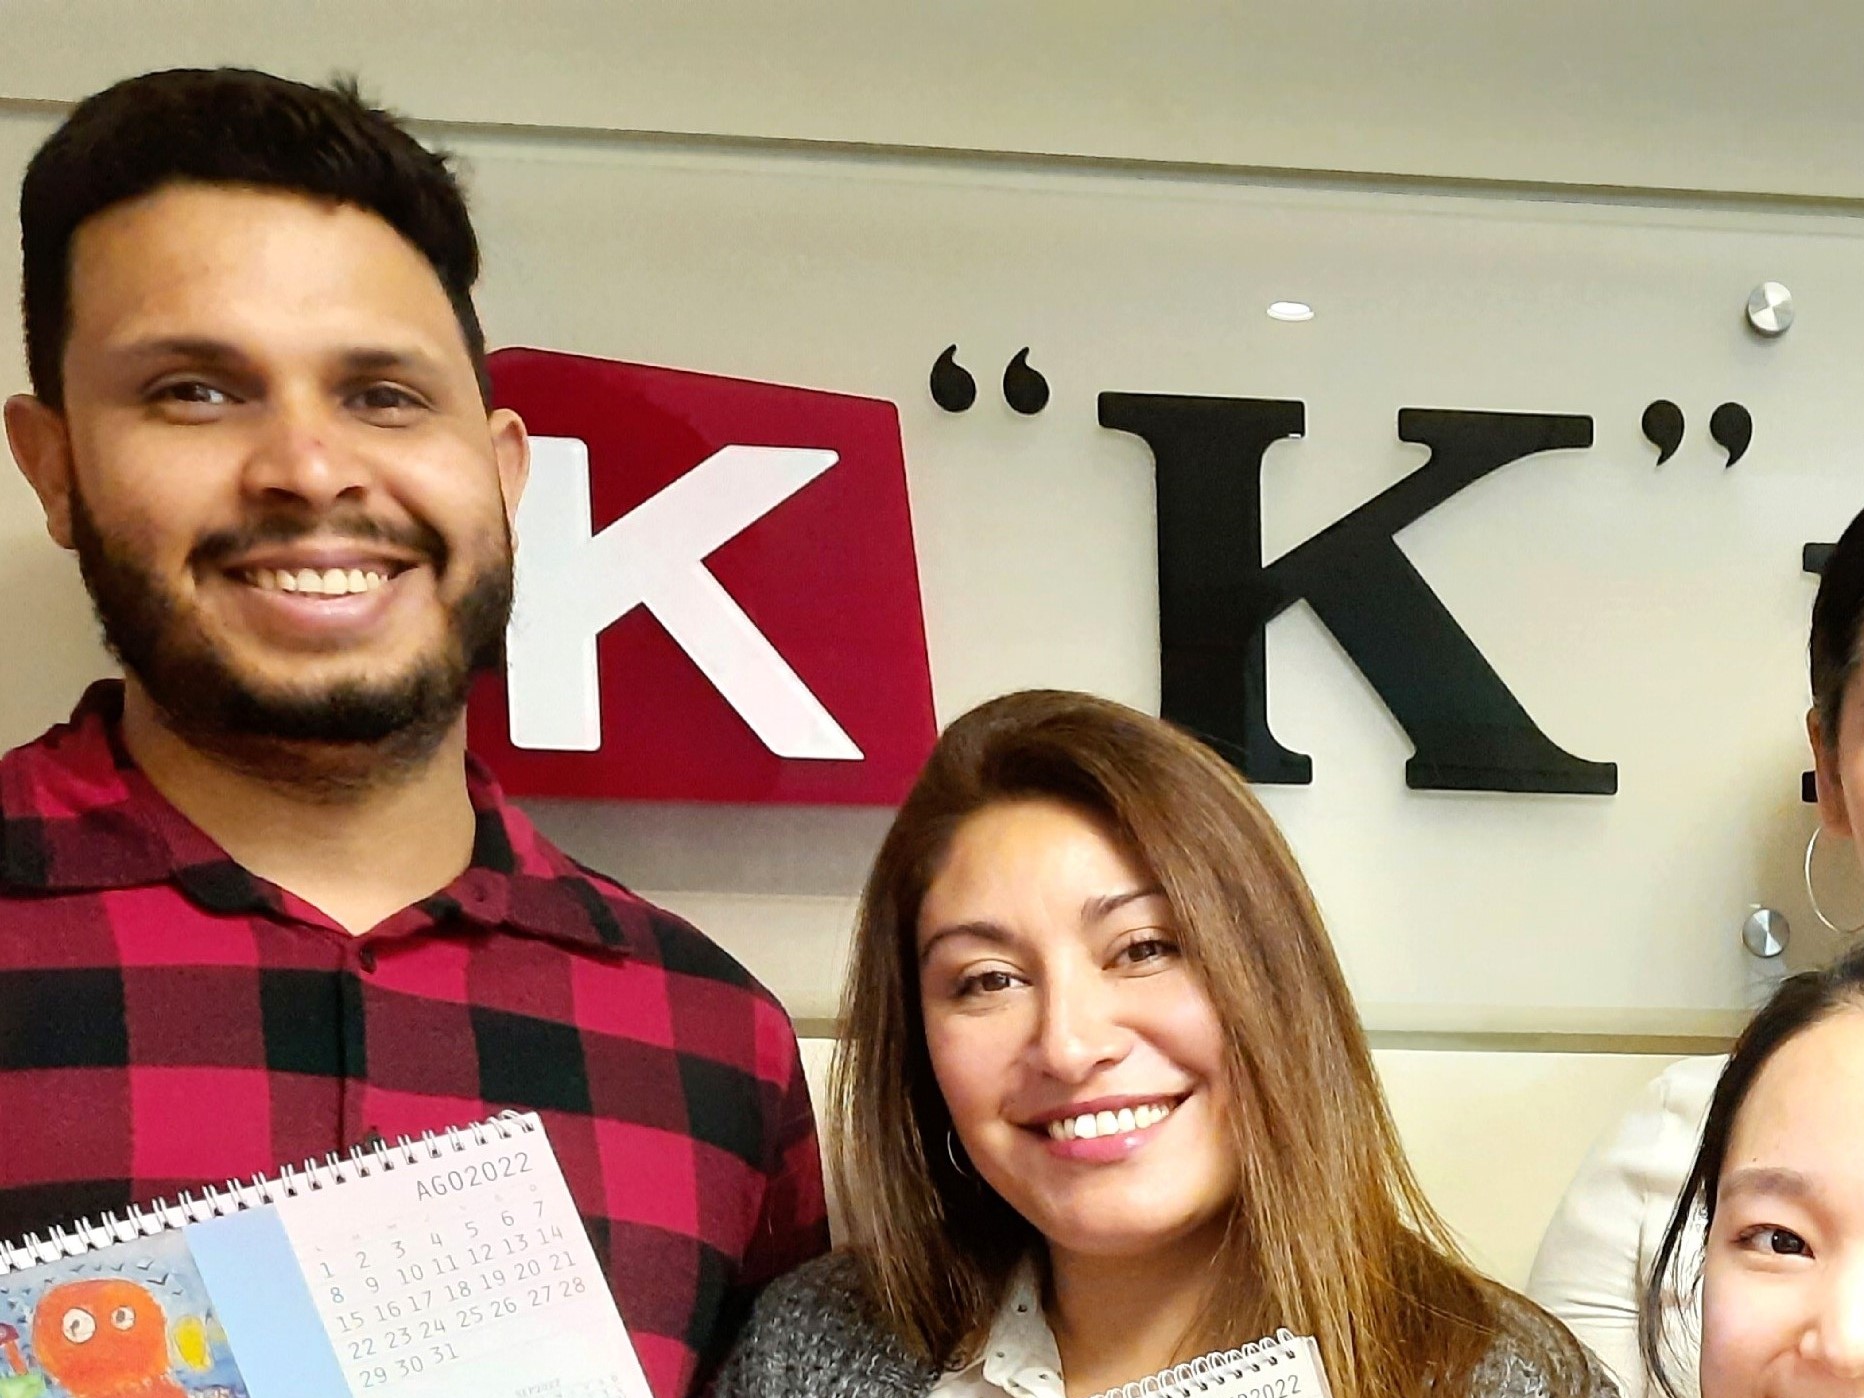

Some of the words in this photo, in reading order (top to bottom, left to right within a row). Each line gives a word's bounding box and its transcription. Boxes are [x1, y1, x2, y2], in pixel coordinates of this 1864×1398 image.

[507, 436, 865, 761] K
[416, 1151, 533, 1202] AGO2022
[320, 1262, 334, 1278] 1
[355, 1251, 370, 1269] 2
[392, 1241, 405, 1258] 3
[431, 1233, 443, 1248] 4
[465, 1221, 478, 1239] 5
[501, 1210, 514, 1226] 6
[533, 1200, 543, 1218] 7
[330, 1287, 344, 1303] 8
[365, 1277, 379, 1294] 9
[397, 1264, 423, 1285] 10
[432, 1255, 460, 1275] 11
[467, 1244, 494, 1265] 12
[503, 1234, 528, 1255] 13
[536, 1225, 563, 1245] 14
[336, 1311, 364, 1333] 15
[374, 1301, 401, 1322] 16
[408, 1290, 431, 1312] 17
[444, 1281, 471, 1302] 18
[480, 1270, 505, 1290] 19
[514, 1259, 540, 1280] 20
[549, 1251, 576, 1271] 21
[348, 1338, 376, 1360] 22
[384, 1327, 412, 1349] 23
[419, 1319, 446, 1339] 24
[456, 1305, 483, 1328] 25
[490, 1297, 517, 1318] 26
[528, 1285, 550, 1307] 27
[559, 1276, 585, 1297] 28
[359, 1367, 387, 1388] 29
[395, 1356, 423, 1378] 30
[429, 1343, 459, 1364] 31
